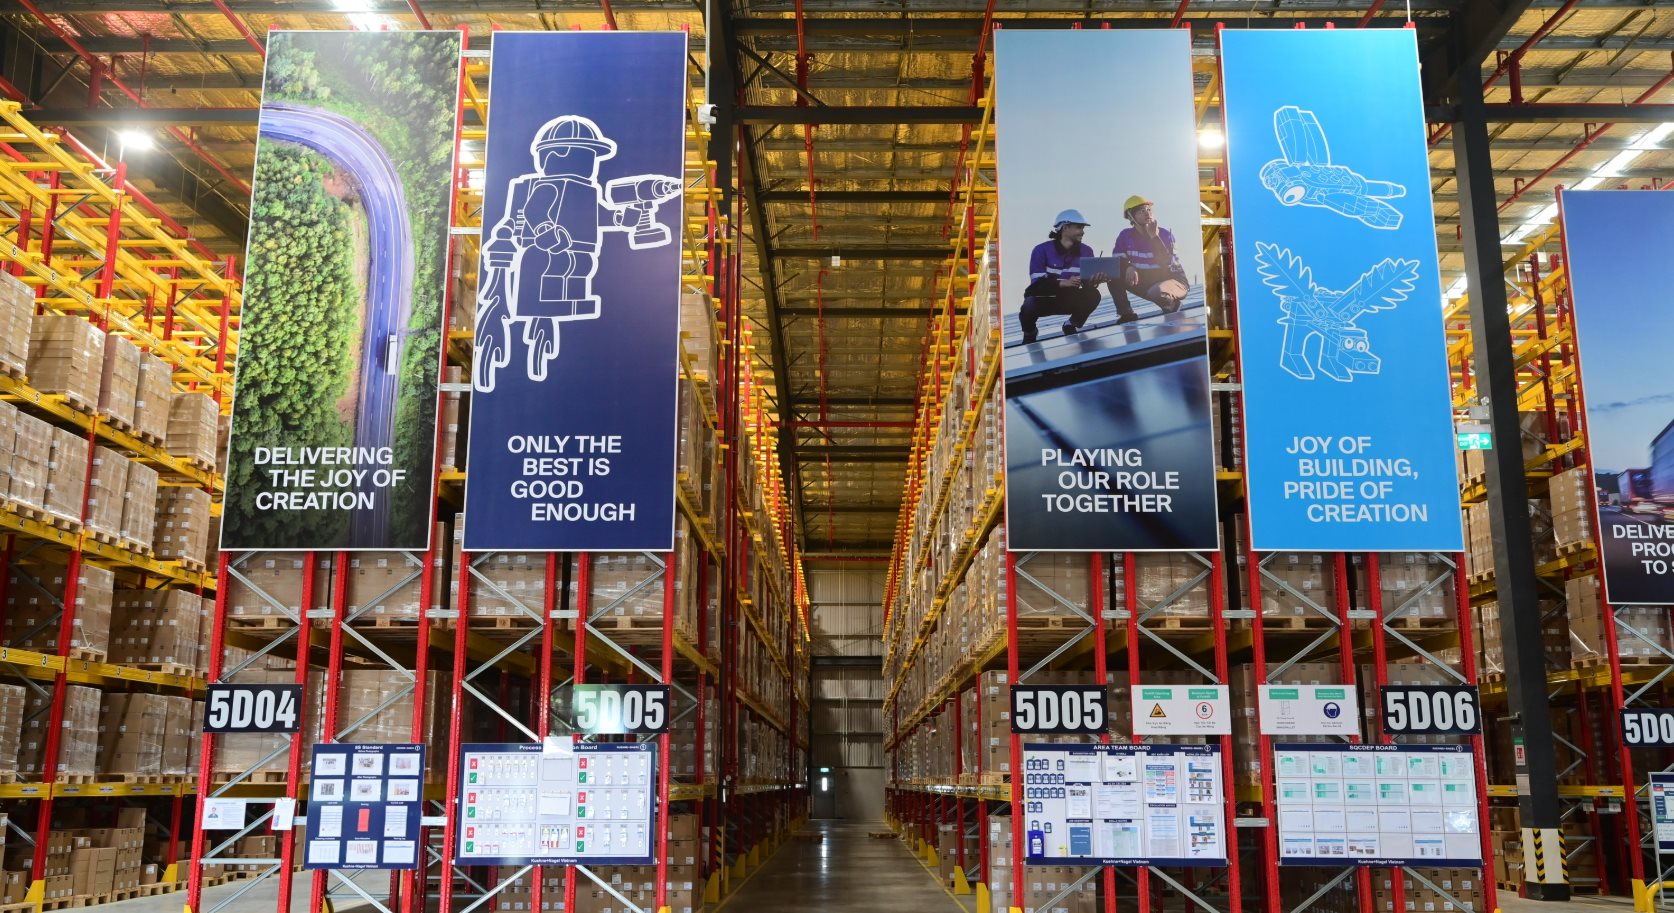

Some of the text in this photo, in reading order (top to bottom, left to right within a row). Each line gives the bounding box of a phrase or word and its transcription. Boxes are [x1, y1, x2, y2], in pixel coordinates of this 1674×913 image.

[507, 435, 622, 454] ONLY THE
[1286, 436, 1372, 454] JOY OF
[254, 447, 393, 465] DELIVERING
[1041, 448, 1142, 467] PLAYING
[522, 457, 610, 476] BEST IS
[1298, 458, 1419, 480] BUILDING,
[268, 469, 407, 488] THE JOY OF
[1058, 471, 1180, 490] OUR ROLE
[510, 480, 584, 499] GOOD
[1283, 481, 1393, 500] PRIDE OF
[255, 491, 375, 510] CREATION
[1041, 494, 1173, 513] TOGETHER
[531, 502, 636, 522] ENOUGH
[1307, 503, 1428, 523] CREATION
[1631, 542, 1674, 557] PRO
[1640, 559, 1668, 575] TO
[1, 649, 7, 660] 3
[42, 655, 48, 665] 3
[209, 690, 296, 729] 5D04
[576, 690, 665, 730] 5D05
[1015, 691, 1103, 730] 5D05
[1201, 704, 1208, 713] 6
[1386, 691, 1475, 730] 5D06
